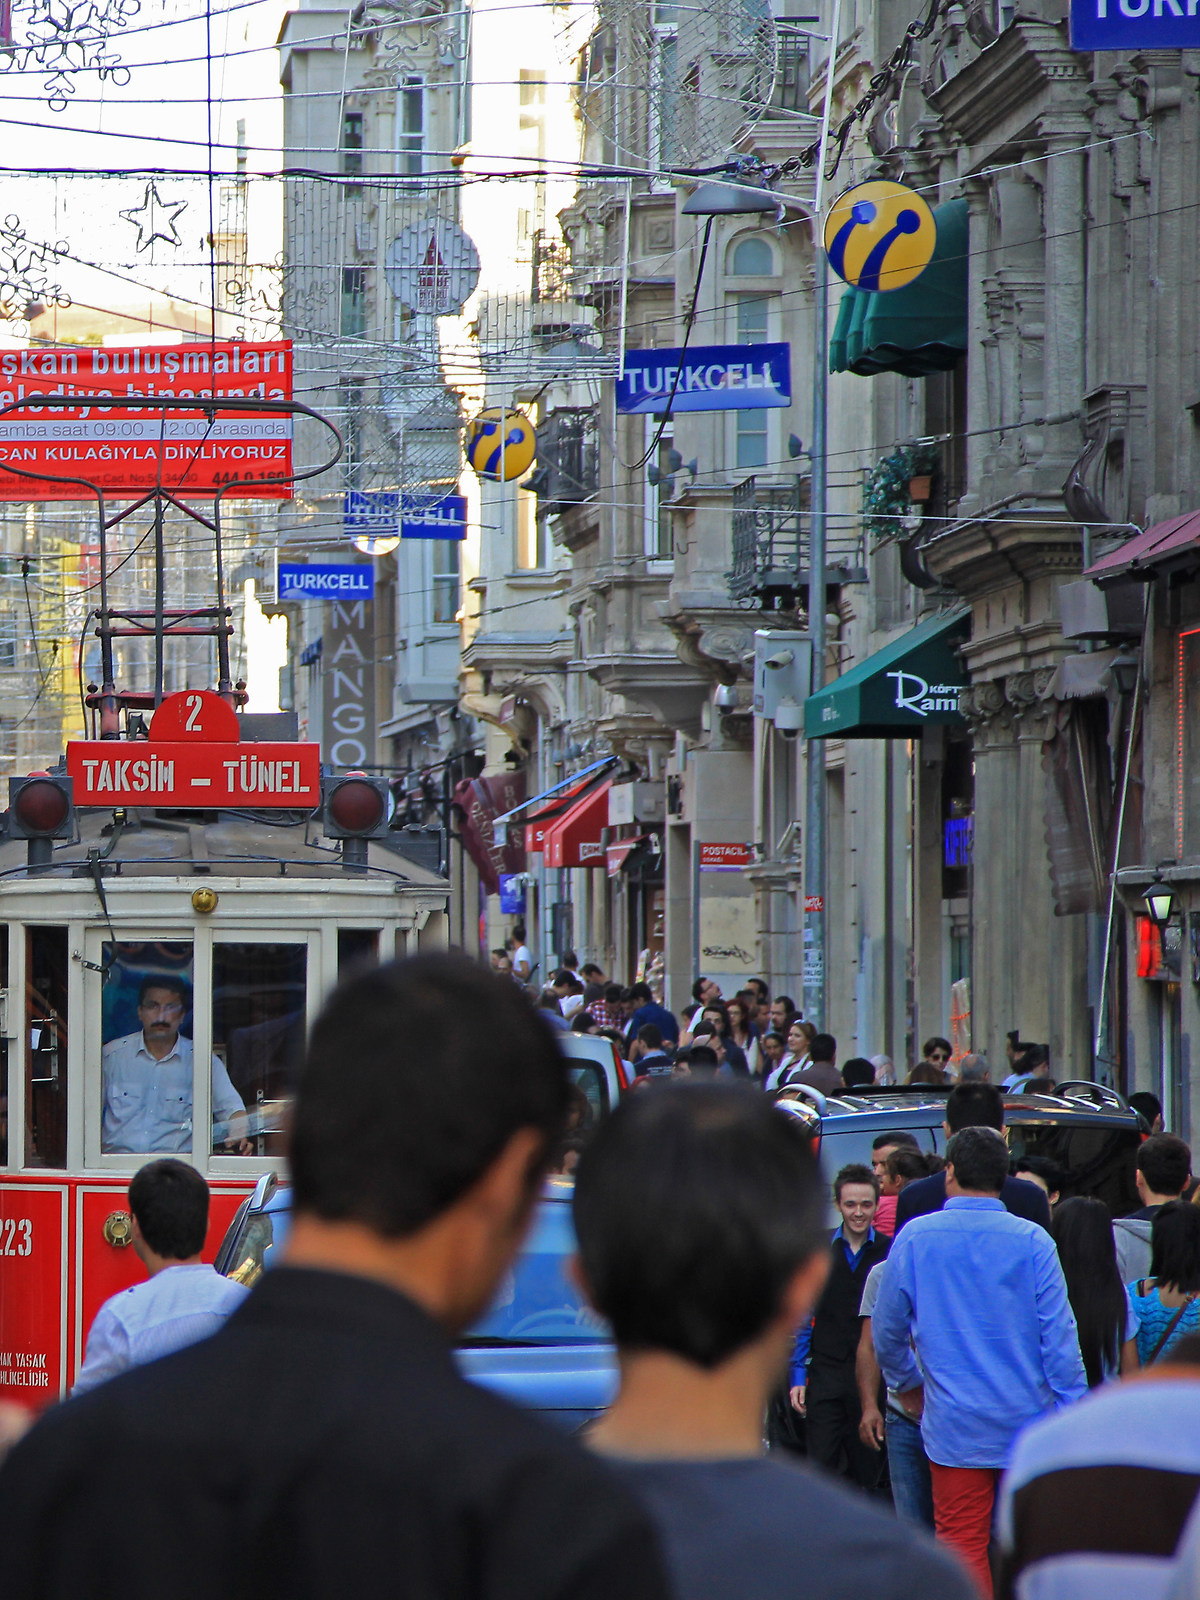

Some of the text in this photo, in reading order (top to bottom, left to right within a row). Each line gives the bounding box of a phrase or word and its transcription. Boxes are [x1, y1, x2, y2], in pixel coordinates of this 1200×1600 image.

[92, 346, 286, 383] buluşmaları
[623, 361, 781, 394] TURKCELL
[52, 423, 89, 437] saat
[93, 421, 144, 436] 09:00
[162, 420, 208, 436] 12:00
[212, 420, 287, 436] arasında
[44, 443, 158, 461] KULAĞIYLA
[164, 443, 287, 460] DİNLİYORUZ
[282, 573, 370, 590] TURKCELL
[330, 600, 367, 767] MANGO
[184, 694, 204, 732] 2
[81, 754, 175, 792] TAKSİM
[222, 754, 311, 793] TÜNEL
[702, 845, 751, 856] POSTACIL
[15, 1352, 47, 1368] YASAK
